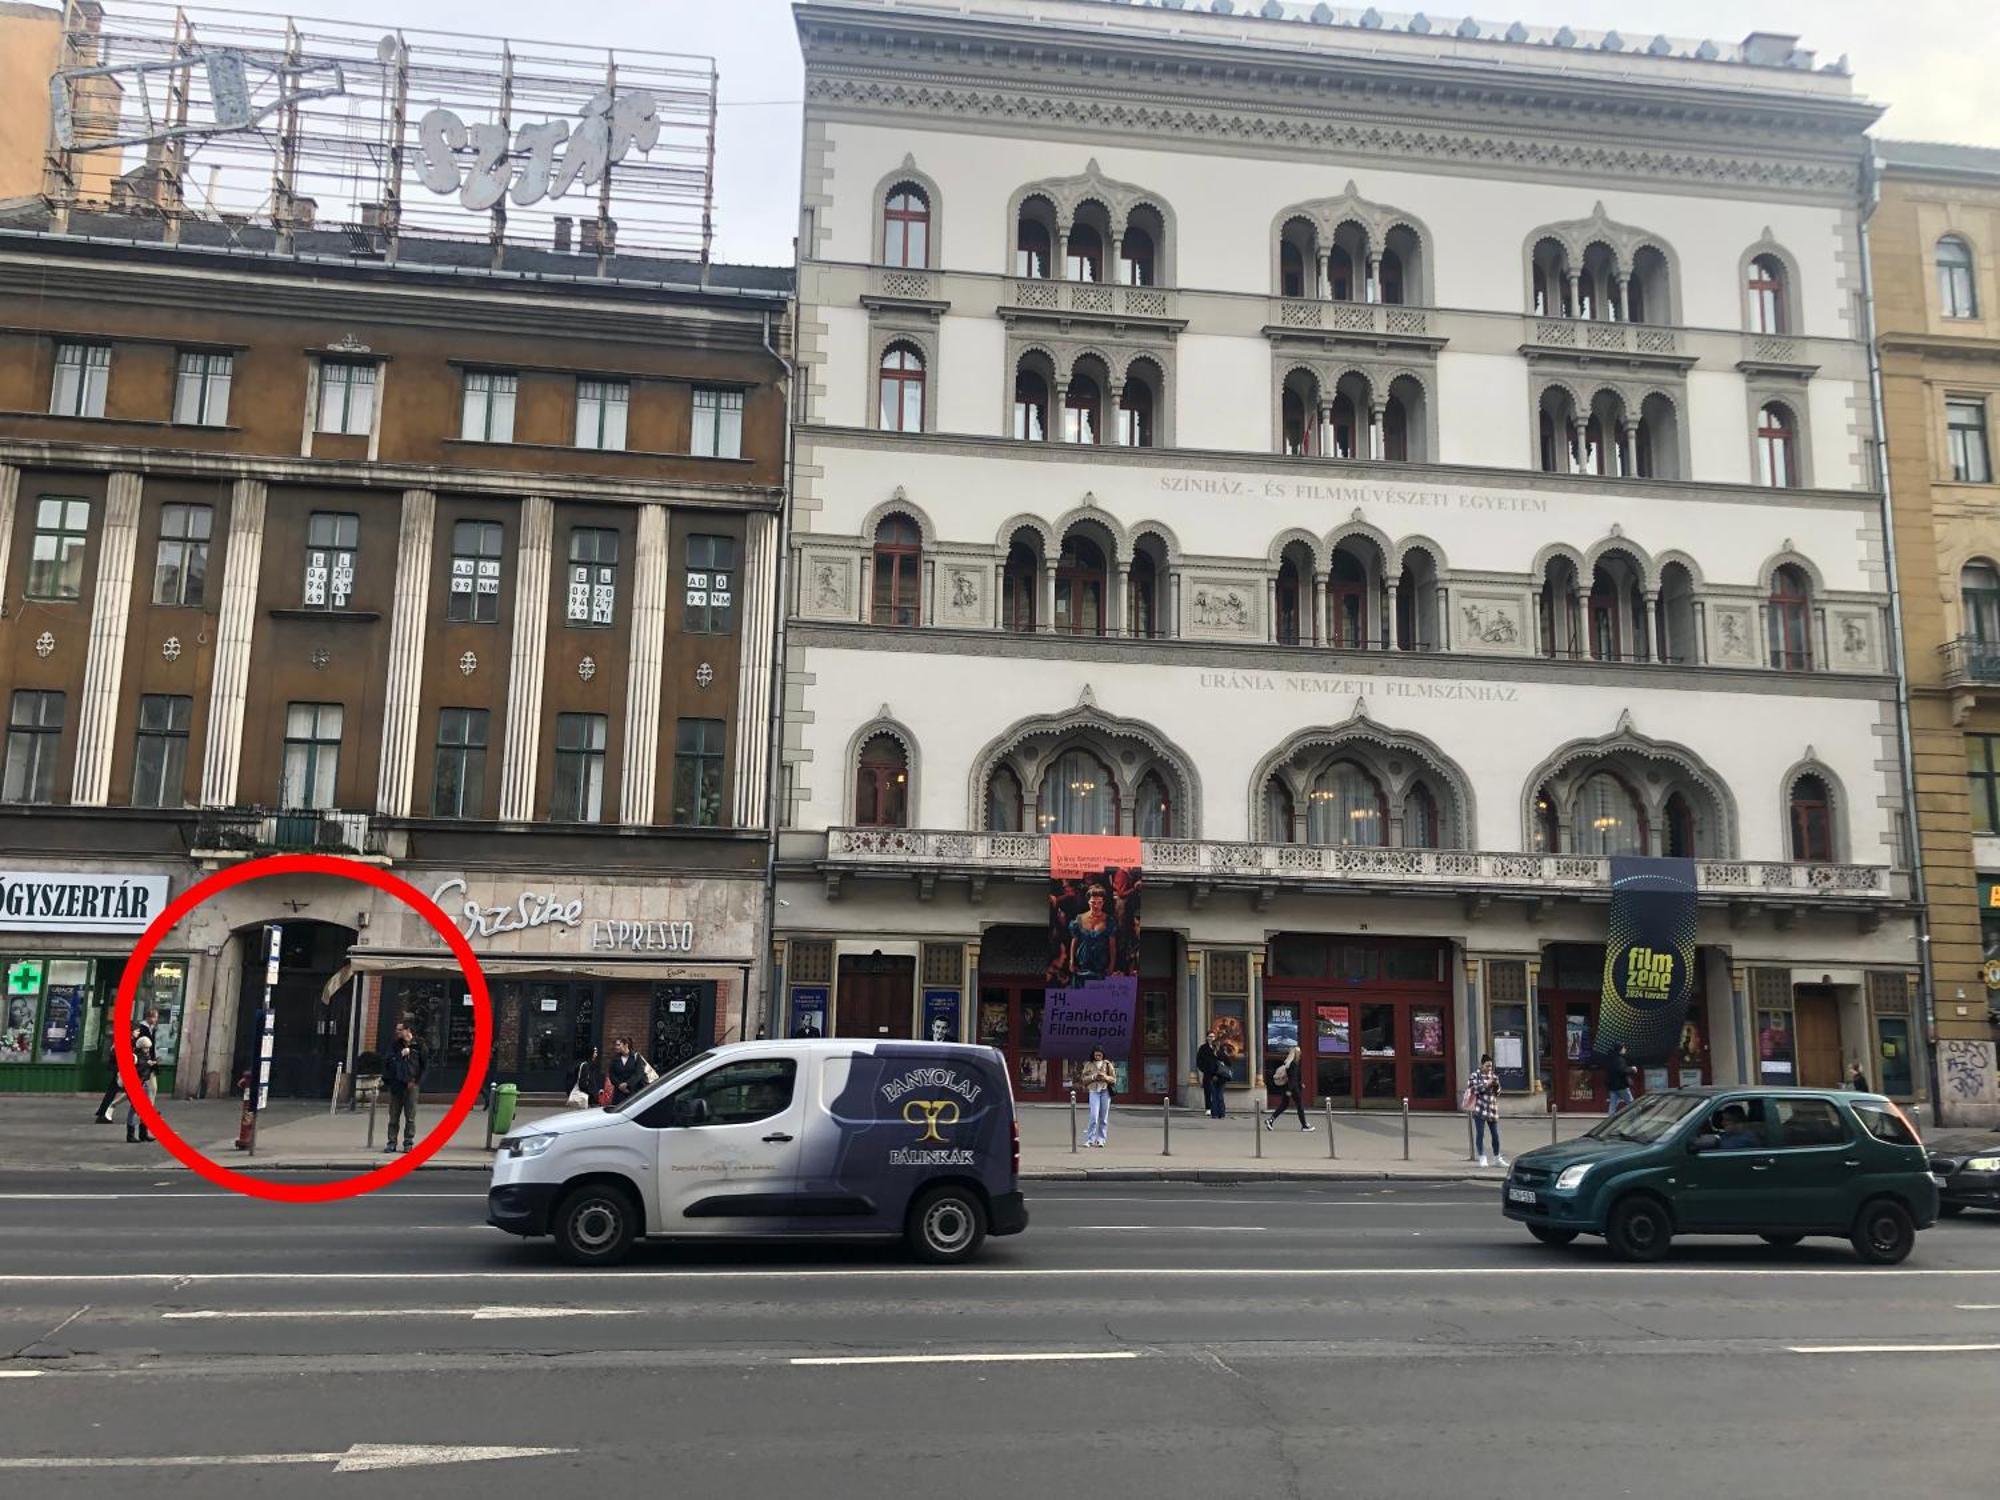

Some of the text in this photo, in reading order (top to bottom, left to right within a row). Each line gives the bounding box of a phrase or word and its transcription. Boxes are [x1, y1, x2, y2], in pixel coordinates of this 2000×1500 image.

[1459, 494, 1547, 512] EGYETEM
[1199, 671, 1518, 702] URÁNIA NEMZETI FILMSZÍNHÁZ
[592, 919, 693, 951] ESPRESSO
[1628, 947, 1674, 972] film
[1626, 969, 1672, 992] zene
[1050, 1007, 1128, 1023] Frankofón
[1049, 1023, 1127, 1039] Filmnapok
[881, 1067, 982, 1103] PANYOLAI
[888, 1146, 975, 1165] PÁLINKÁK
